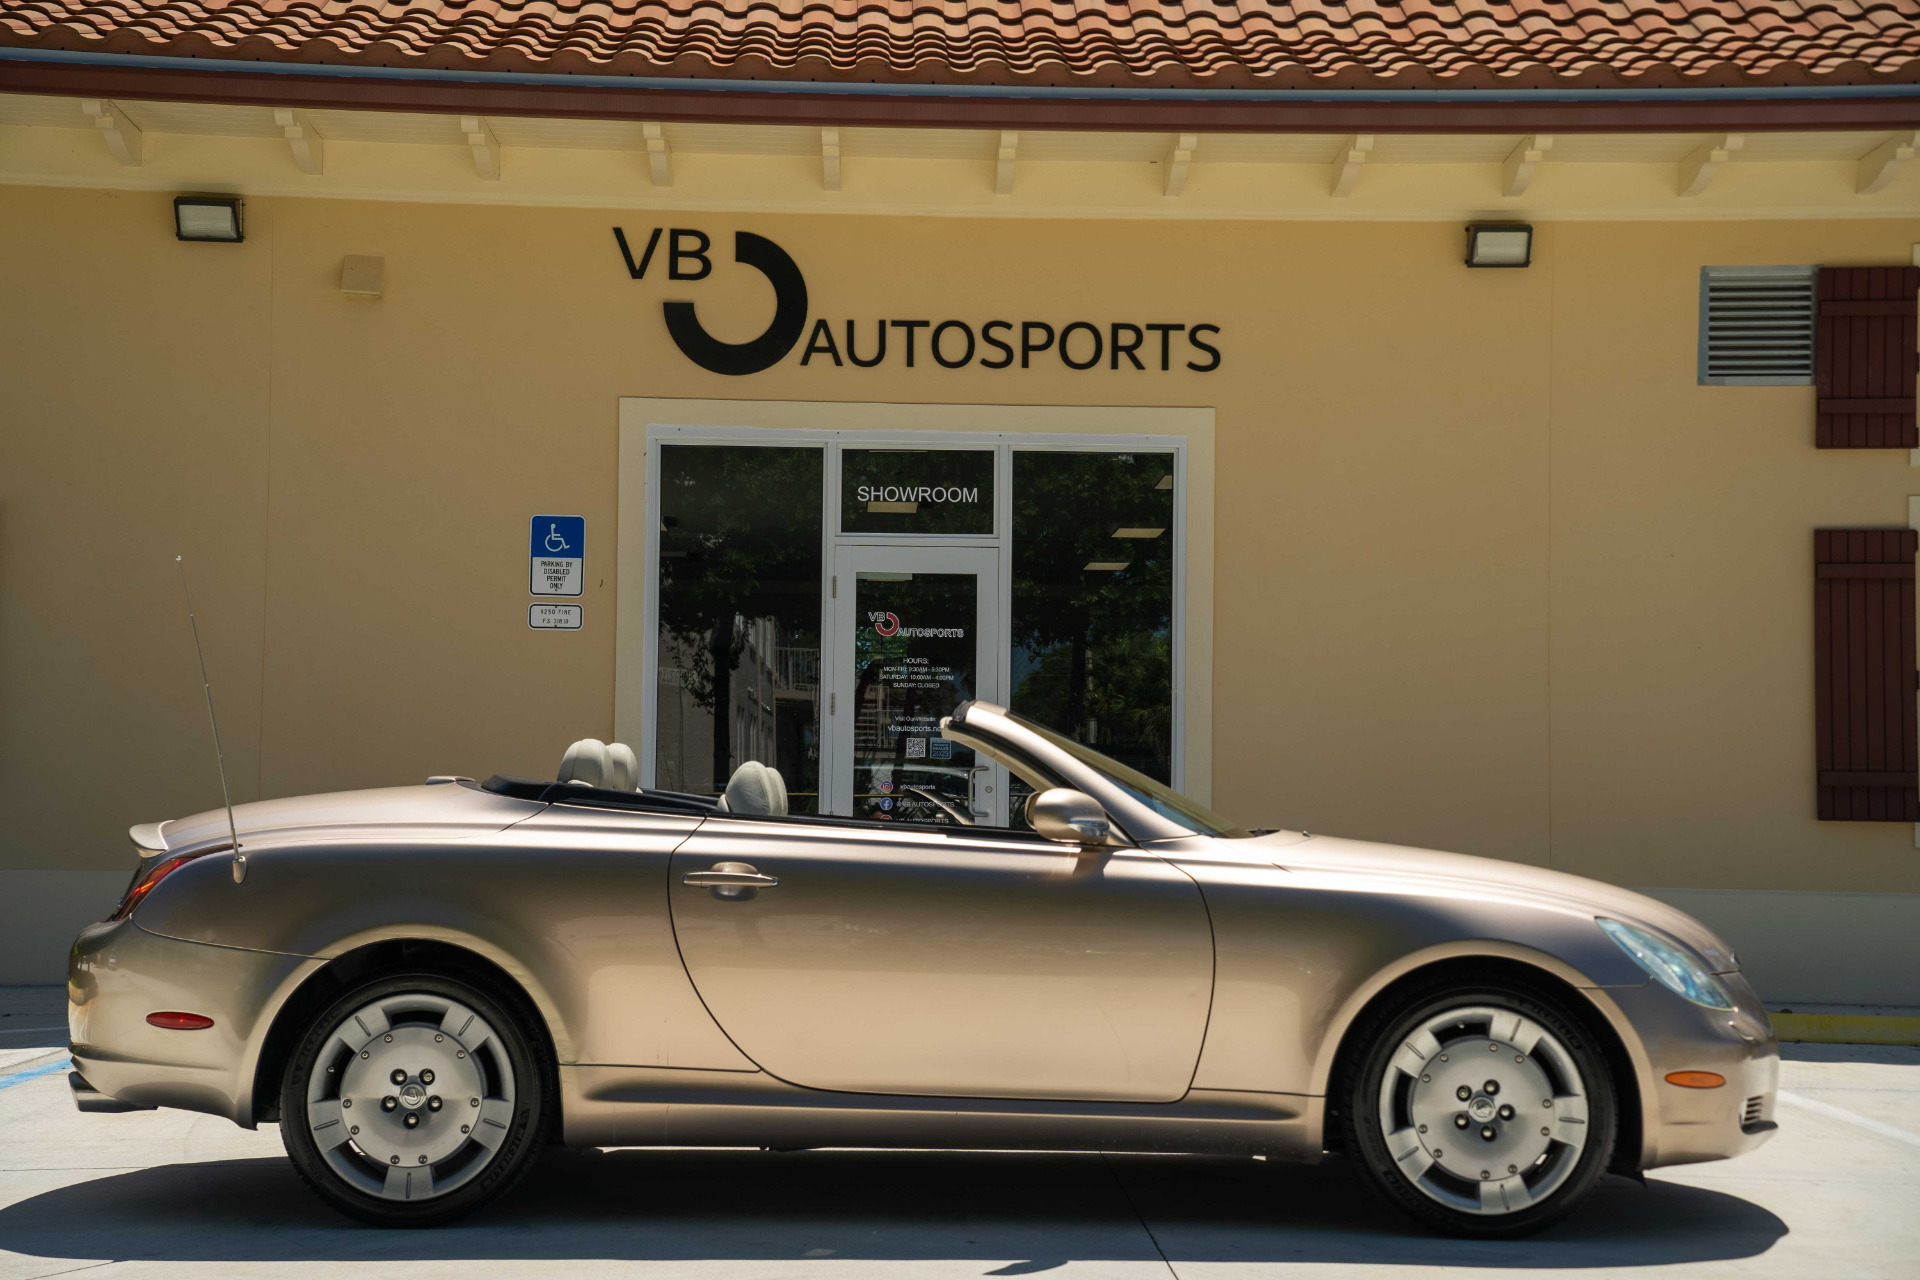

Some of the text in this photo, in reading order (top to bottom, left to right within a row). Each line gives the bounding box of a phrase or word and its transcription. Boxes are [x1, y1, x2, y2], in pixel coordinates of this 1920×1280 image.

[612, 227, 712, 280] VB
[799, 318, 1222, 372] AUTOSPORTS
[857, 486, 978, 503] SHOWROOM
[868, 612, 886, 621] VB
[897, 628, 964, 638] AUTOSPORTS
